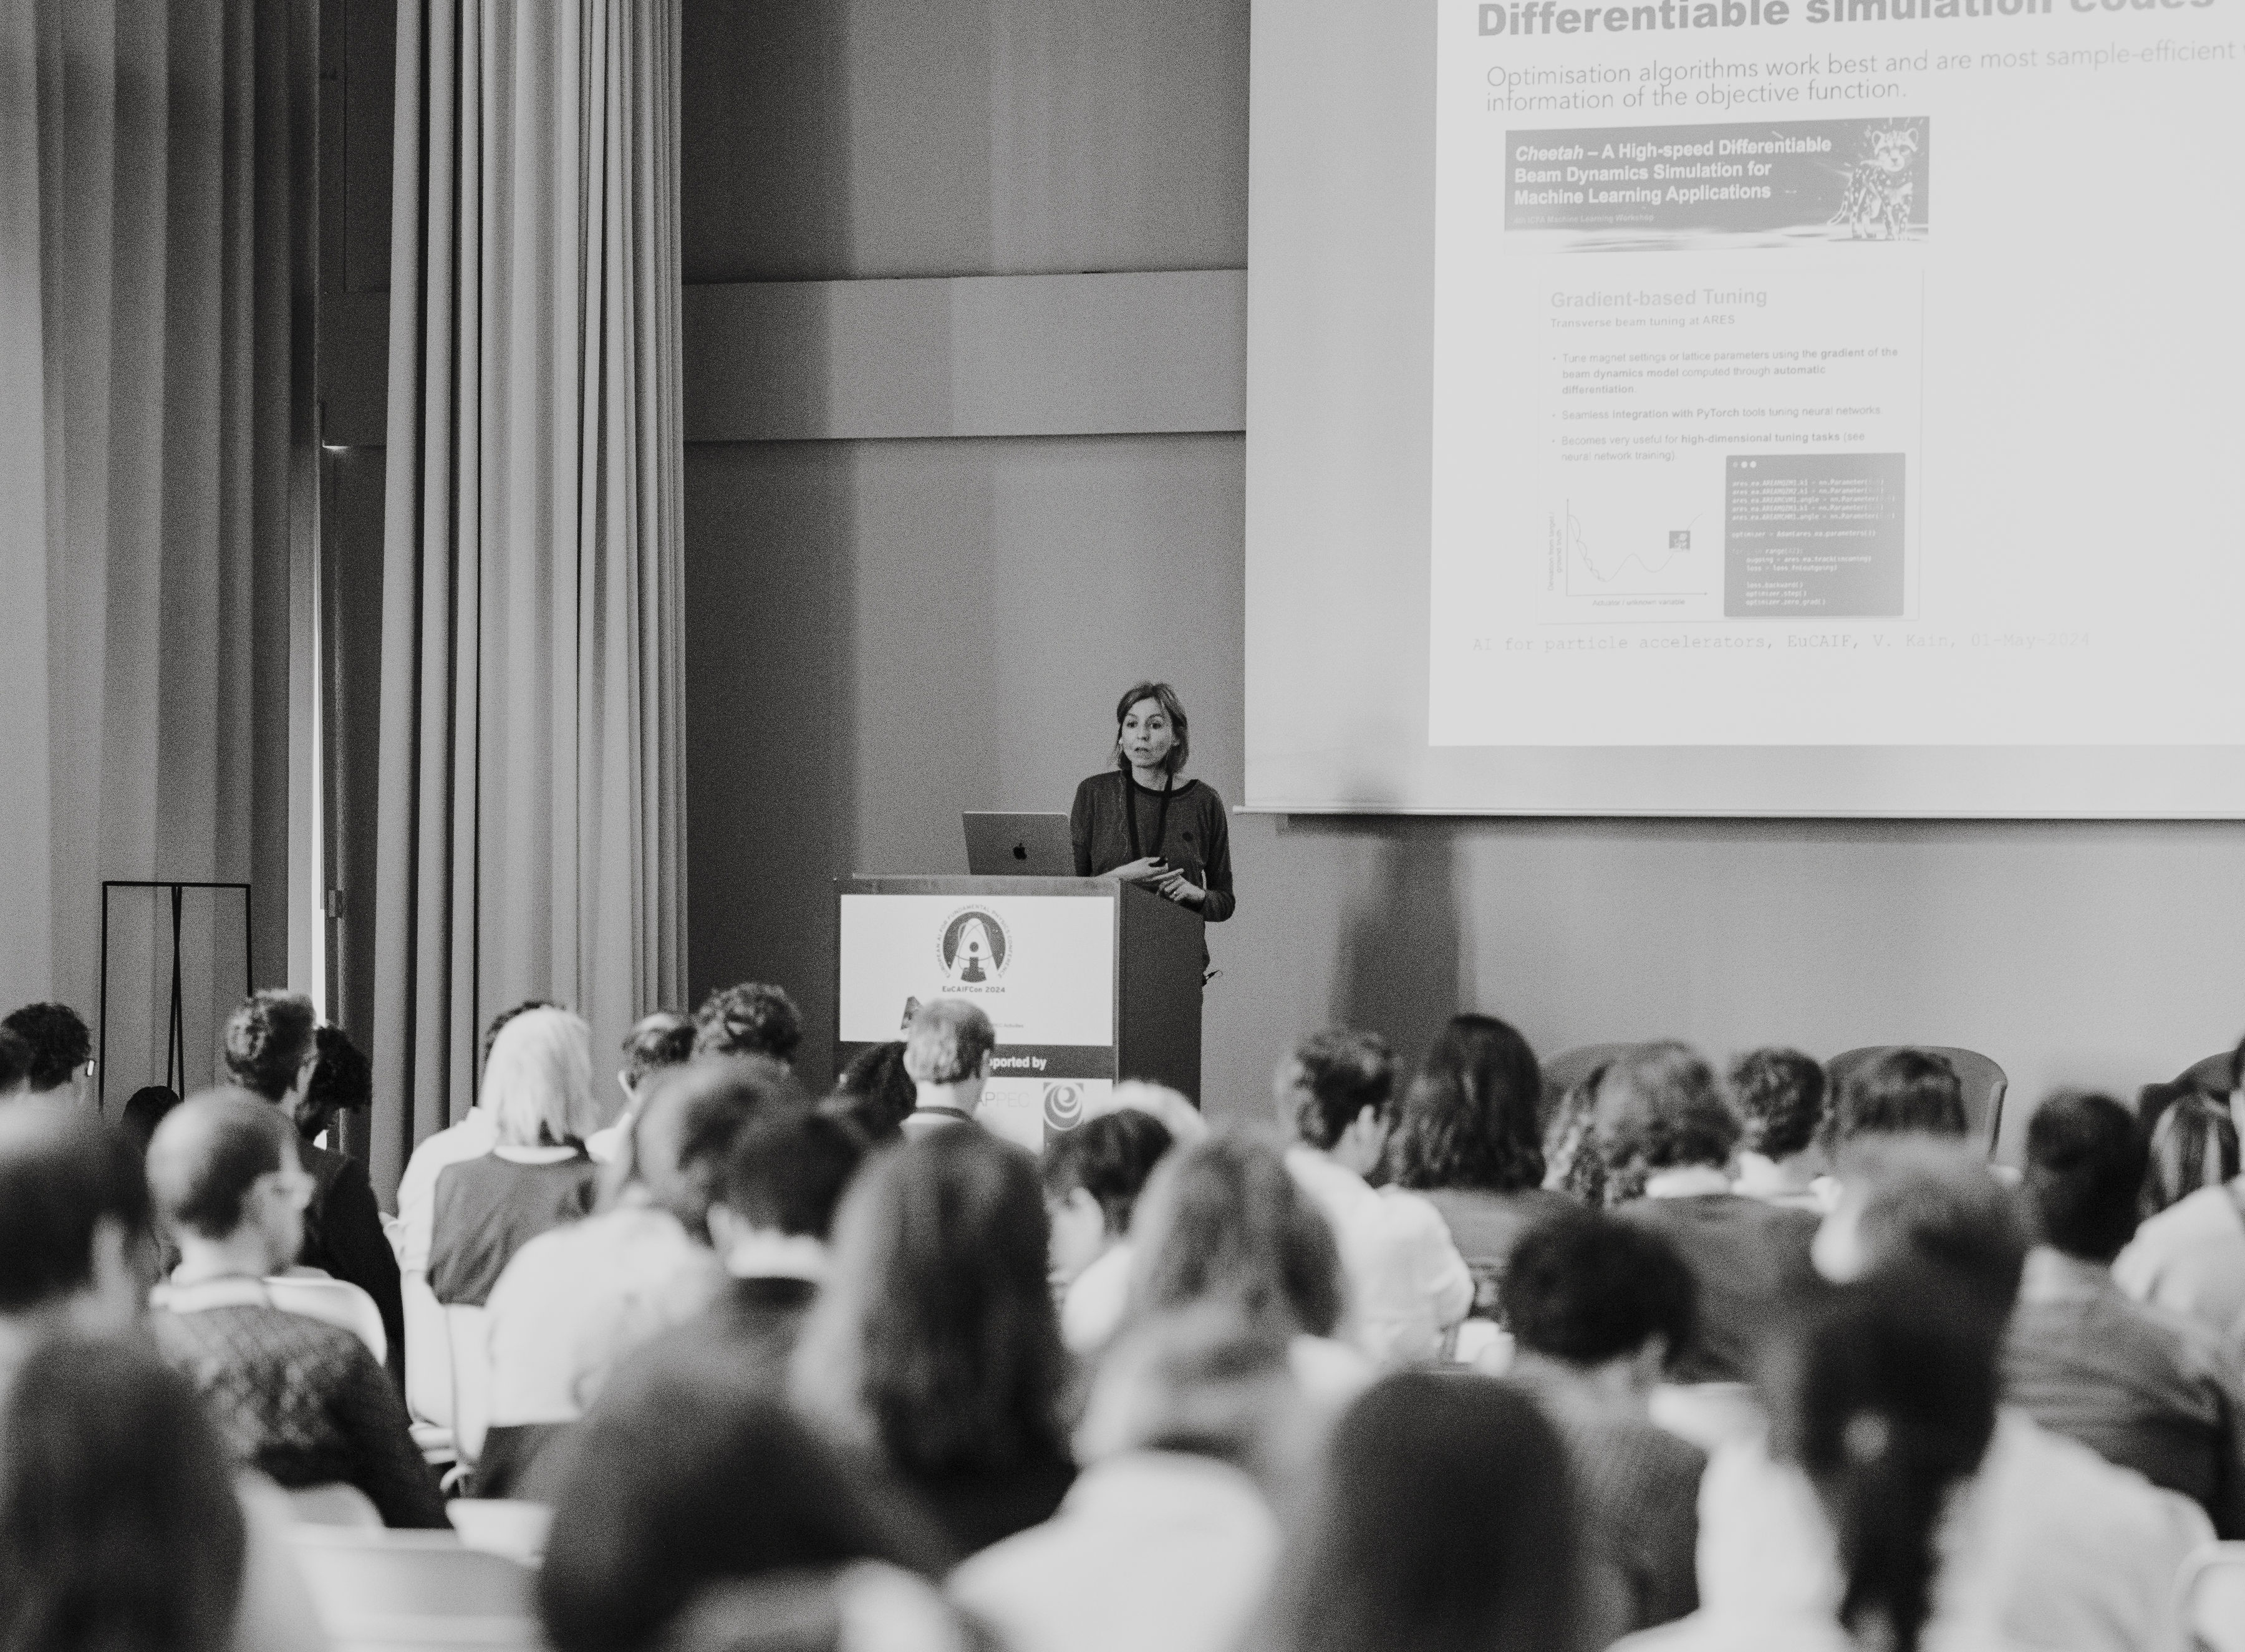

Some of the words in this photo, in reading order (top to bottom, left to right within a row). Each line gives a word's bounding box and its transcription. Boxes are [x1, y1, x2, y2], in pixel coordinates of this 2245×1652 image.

[1479, 0, 1789, 36] Differentiable
[1487, 64, 1630, 92] Optimisation
[1639, 57, 1758, 85] algorithms
[1766, 54, 1820, 77] work
[1828, 53, 1877, 74] best
[1886, 49, 1928, 71] and
[1936, 52, 1971, 69] are
[1981, 49, 2037, 68] most
[2046, 39, 2236, 71] sample-efficient
[1487, 87, 1614, 112] information
[1623, 85, 1645, 107] of
[1652, 82, 1687, 105] the
[1696, 84, 1799, 110] objective
[1808, 79, 1906, 100] function.
[1515, 146, 1583, 162] Cheetah
[1601, 145, 1615, 158] A
[1618, 141, 1714, 160] High-speed
[1719, 137, 1832, 155] Differentiable
[1515, 168, 1562, 183] Beam
[1567, 165, 1648, 185] Dynamics
[1653, 162, 1742, 179] Simulation
[1747, 161, 1772, 176] for
[1514, 188, 1583, 205] Machine
[1588, 186, 1661, 205] Learning
[1666, 183, 1771, 203] Applications
[1547, 215, 1578, 223] Machine
[1580, 215, 1613, 224] Learning
[1615, 214, 1654, 223] Workshop
[1550, 289, 1696, 308] Gradient-based
[1703, 287, 1768, 307] Tuning
[1550, 318, 1611, 328] Transverse
[1616, 317, 1646, 327] beam
[1649, 317, 1686, 329] tuning
[1689, 317, 1699, 326] at
[1703, 315, 1735, 325] ARES
[1562, 353, 1586, 364] Tune
[1590, 353, 1626, 365] magnet
[1628, 352, 1666, 364] settings
[1683, 351, 1711, 361] lattice
[1714, 351, 1769, 363] parameters
[1772, 350, 1799, 361] using
[1802, 349, 1817, 359] the
[1820, 347, 1865, 360] gradient
[1868, 347, 1878, 357] of
[1881, 347, 1898, 357] the
[1562, 369, 1590, 379] beam
[1593, 367, 1643, 380] dynamics
[1647, 367, 1679, 377] model
[1682, 366, 1730, 378] computed
[1733, 365, 1770, 377] through
[1774, 364, 1826, 375] automatic
[1562, 410, 1609, 420] Seamless
[1612, 408, 1668, 421] integration
[1671, 408, 1694, 418] with
[1696, 407, 1739, 420] PyTorch
[1802, 405, 1833, 415] neural
[1562, 435, 1607, 446] Becomes
[1610, 438, 1630, 447] very
[1633, 434, 1662, 444] useful
[1664, 434, 1678, 444] for
[1681, 432, 1772, 445] high-dimensional
[1775, 432, 1808, 443] tuning
[1812, 432, 1840, 442] tasks
[1562, 452, 1591, 461] neural
[1594, 450, 1633, 460] network
[1473, 638, 1492, 651] AI
[1505, 637, 1534, 651] for
[1544, 635, 1628, 653] particle
[1639, 635, 1772, 650] accelerators,
[1787, 634, 1859, 650] EuCAIF,
[1873, 634, 1891, 648] V.
[1032, 1056, 1046, 1071] by
[983, 1092, 1030, 1108] PPEC
